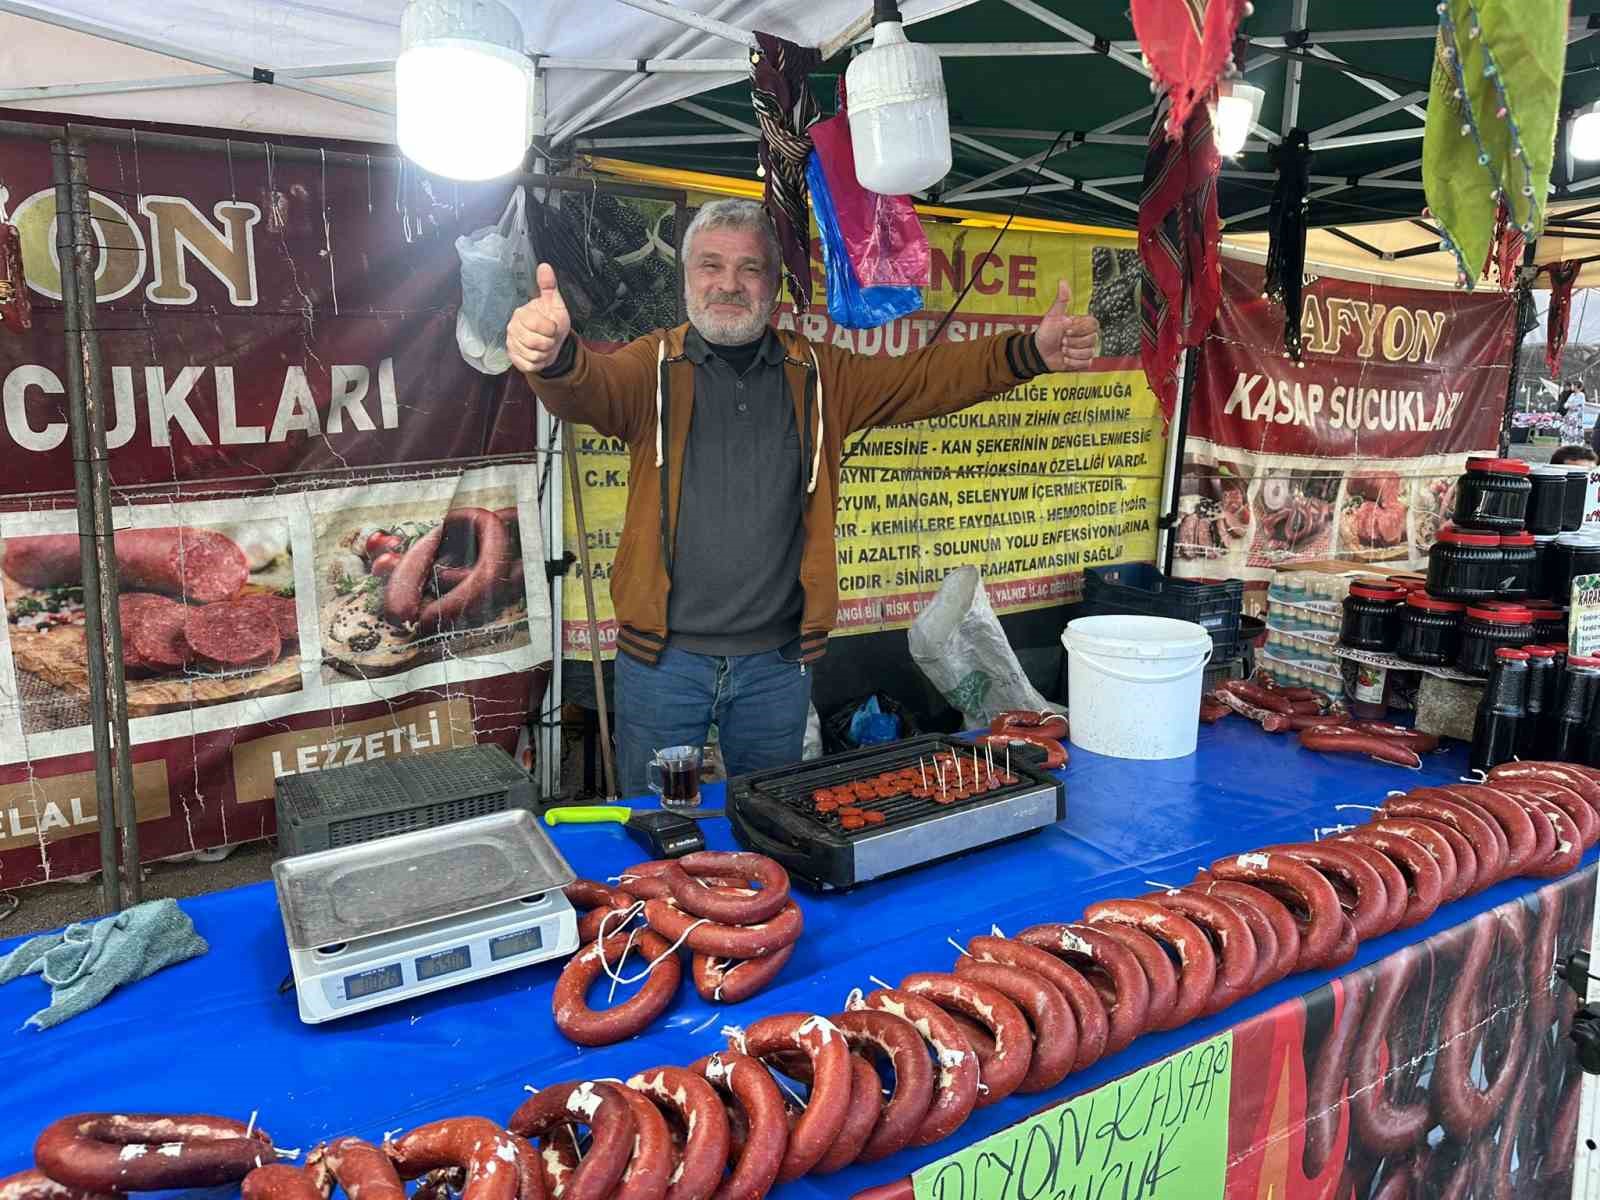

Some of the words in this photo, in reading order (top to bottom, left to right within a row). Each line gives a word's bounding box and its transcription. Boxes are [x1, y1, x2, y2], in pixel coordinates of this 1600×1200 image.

[0, 184, 261, 306] ON
[1301, 294, 1445, 362] AFYON
[1223, 372, 1325, 428] KASAP
[928, 412, 1021, 432] ÇOCUKLARIN
[1024, 410, 1059, 426] ZİHİN
[1063, 406, 1132, 425] GELİŞİMİNE
[940, 440, 970, 456] KAN
[976, 436, 1048, 458] ŞEKERİNİN
[840, 467, 875, 485] AYNI
[880, 466, 951, 484] ZAMANDA
[885, 490, 953, 512] MANGAN,
[957, 486, 1029, 506] SELENYUM
[1031, 477, 1128, 501] İÇERMEKTEDİR.
[871, 515, 955, 538] KEMİKLERE
[959, 510, 1036, 530] FAYDALIDIR
[858, 543, 921, 564] AZALTIR
[934, 537, 1002, 558] SOLUNUM
[1005, 534, 1038, 552] YOLU
[981, 551, 1080, 578] RAHATLAMASINI
[886, 598, 912, 617] RİSK
[273, 709, 440, 779] LEZZETLİ
[1096, 1040, 1229, 1172] KASAP
